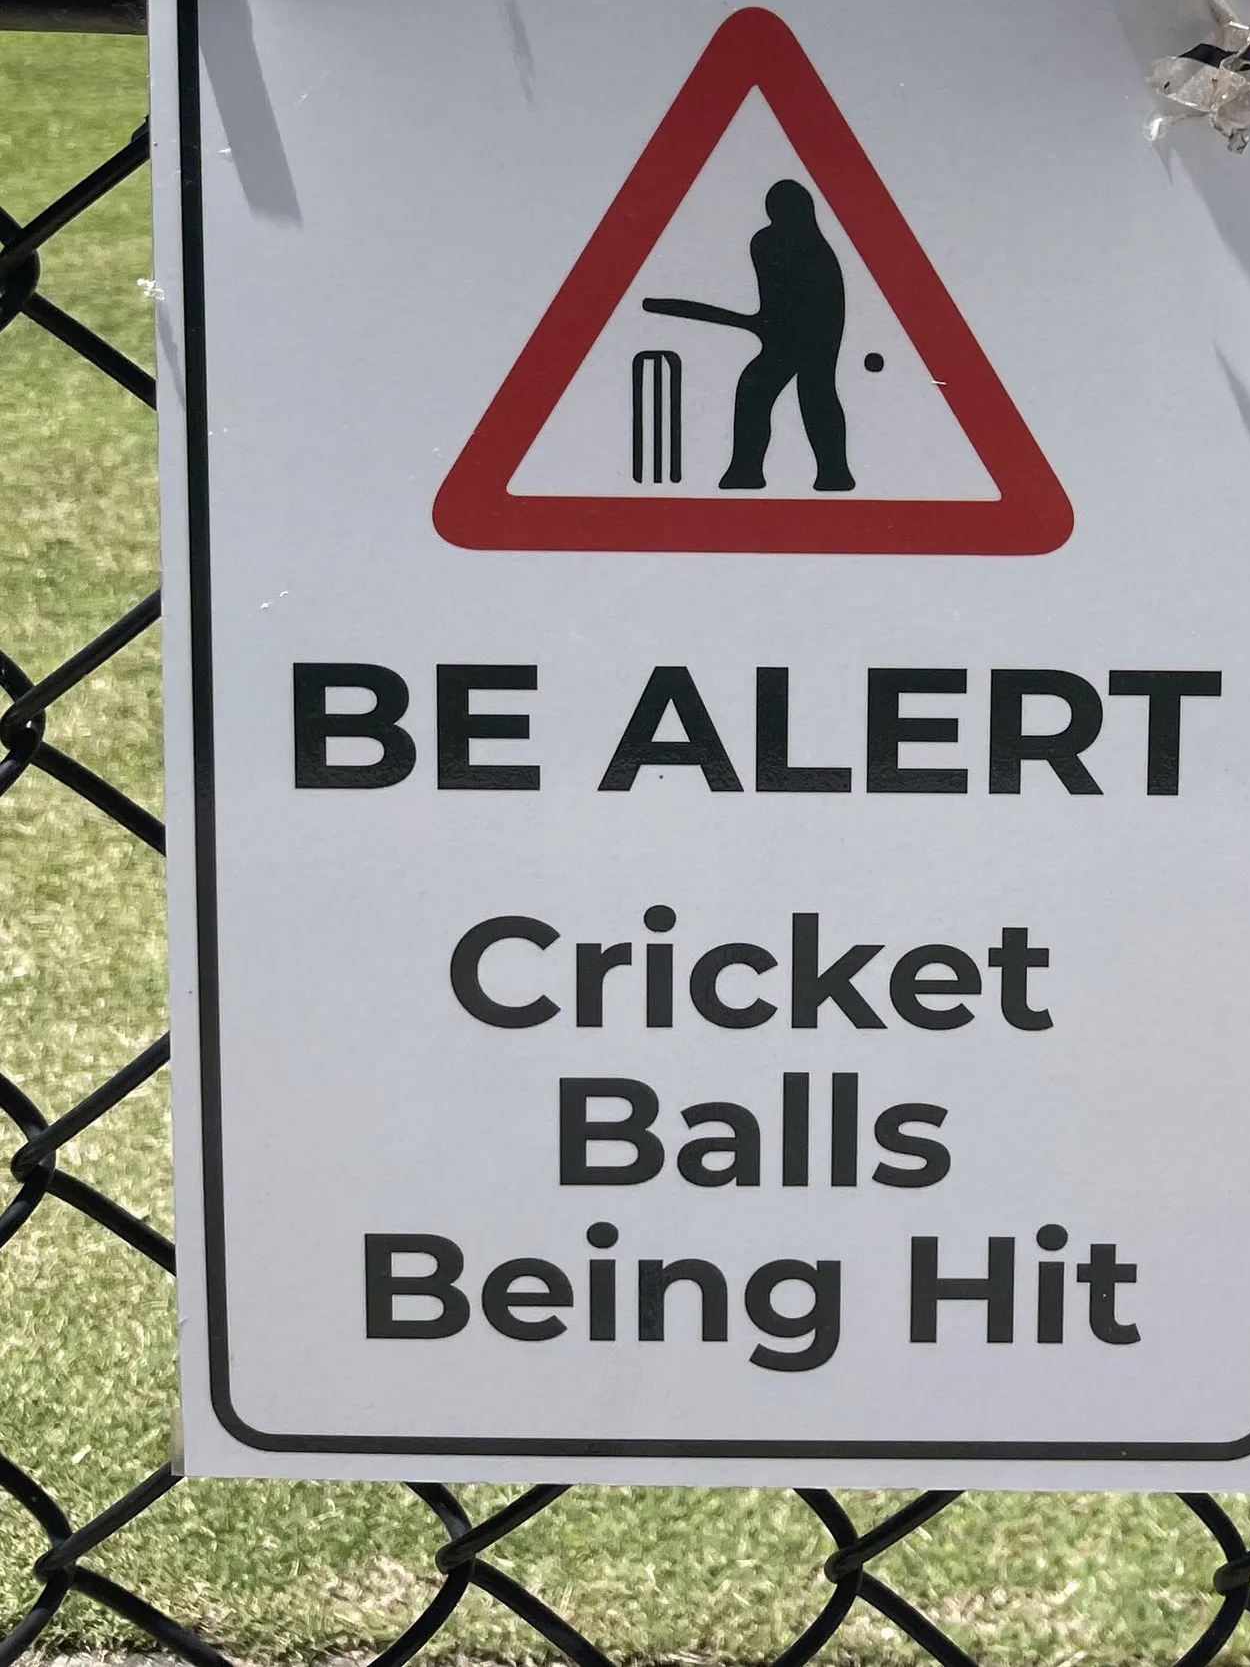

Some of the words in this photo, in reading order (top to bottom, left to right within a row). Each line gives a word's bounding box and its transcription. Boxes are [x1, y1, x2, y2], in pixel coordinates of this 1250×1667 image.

[292, 662, 541, 791] BE
[597, 665, 1223, 797] ALERT
[449, 904, 1054, 1032] Cricket
[558, 1071, 951, 1189] Balls
[363, 1221, 842, 1373] Being
[909, 1223, 1142, 1346] Hit
